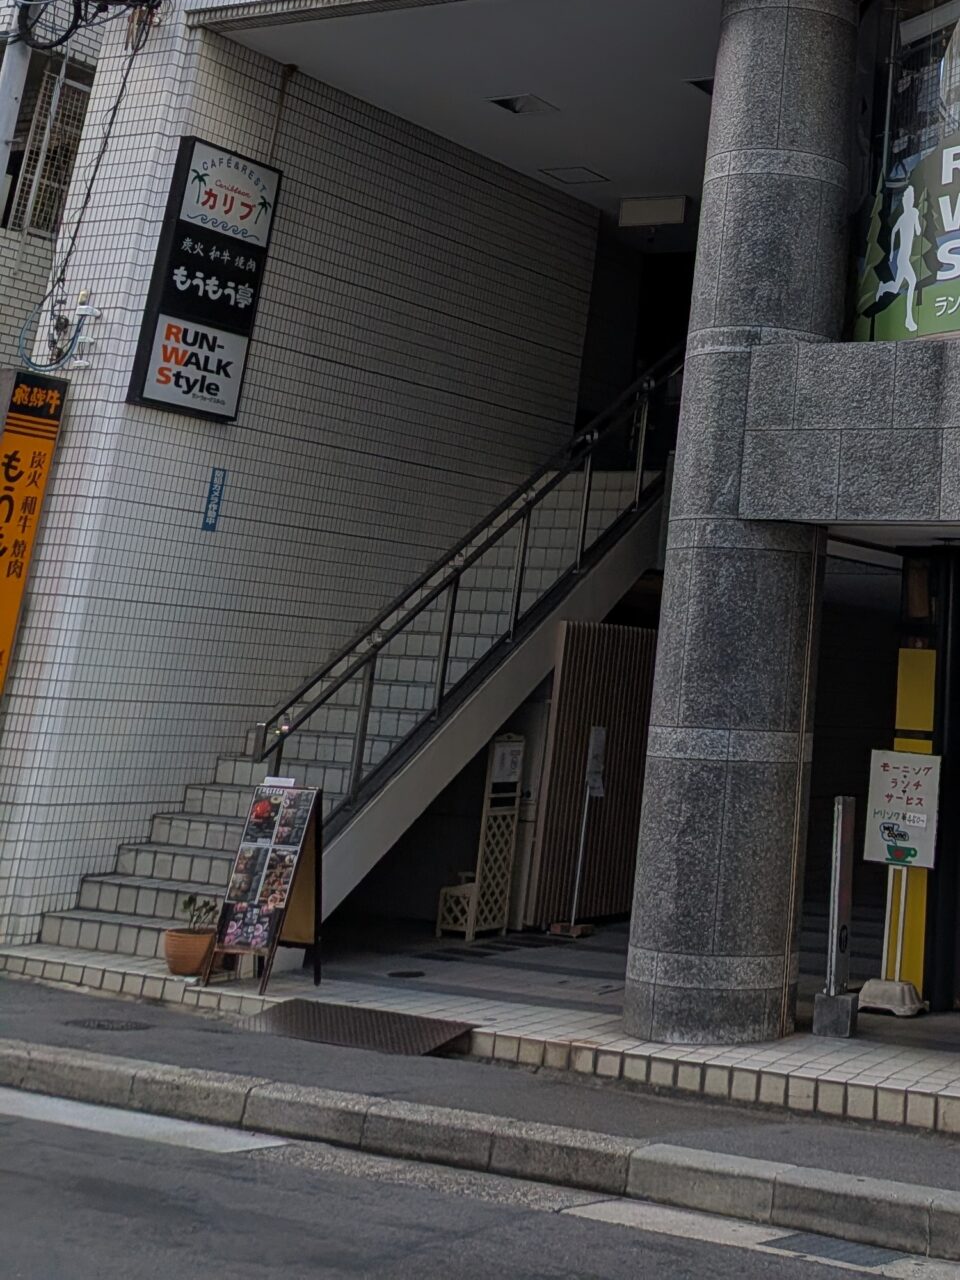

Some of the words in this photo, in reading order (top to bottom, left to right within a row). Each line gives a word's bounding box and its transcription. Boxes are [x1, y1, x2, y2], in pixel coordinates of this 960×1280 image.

[201, 188, 257, 221] カリブ
[181, 237, 205, 257] 炭火
[208, 246, 231, 264] 和牛
[173, 266, 254, 308] もうもう亭
[161, 344, 234, 379] WALK
[155, 366, 220, 396] Style
[25, 451, 47, 489] 炭火
[19, 495, 38, 534] 和牛
